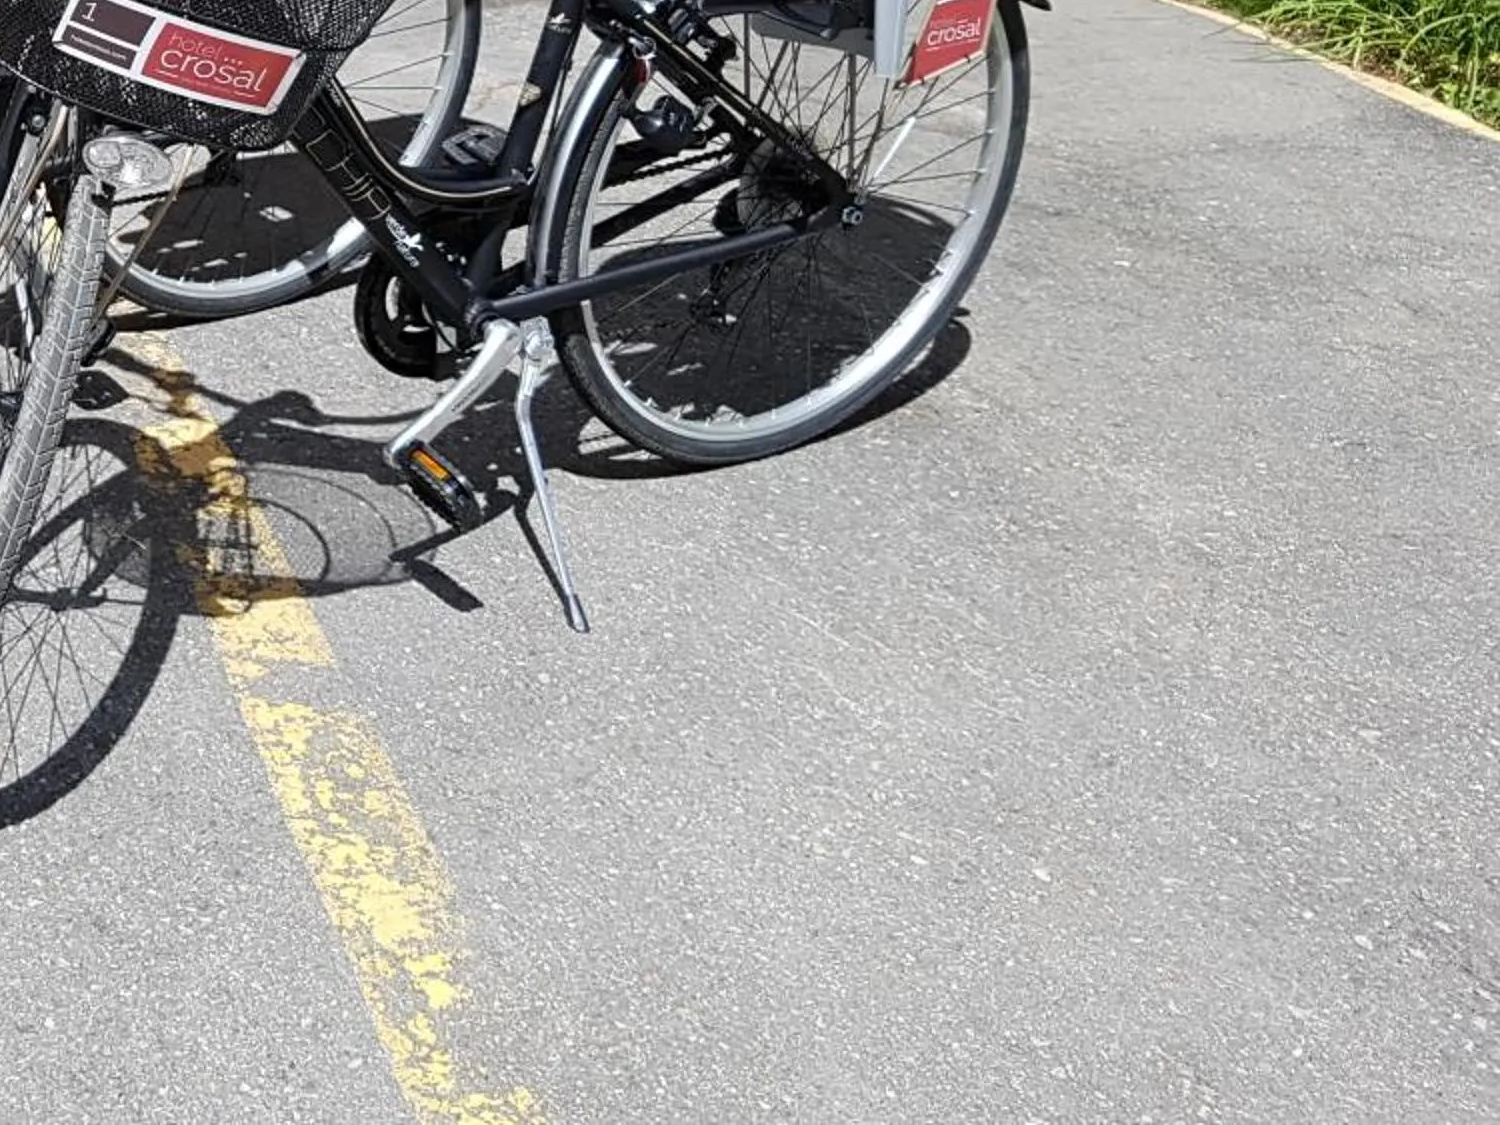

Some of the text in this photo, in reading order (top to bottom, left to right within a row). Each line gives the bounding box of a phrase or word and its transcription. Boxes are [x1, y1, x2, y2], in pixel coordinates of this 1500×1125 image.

[80, 2, 97, 23] 1
[927, 16, 981, 46] crosal
[168, 32, 224, 62] hotel
[160, 49, 268, 92] crosal
